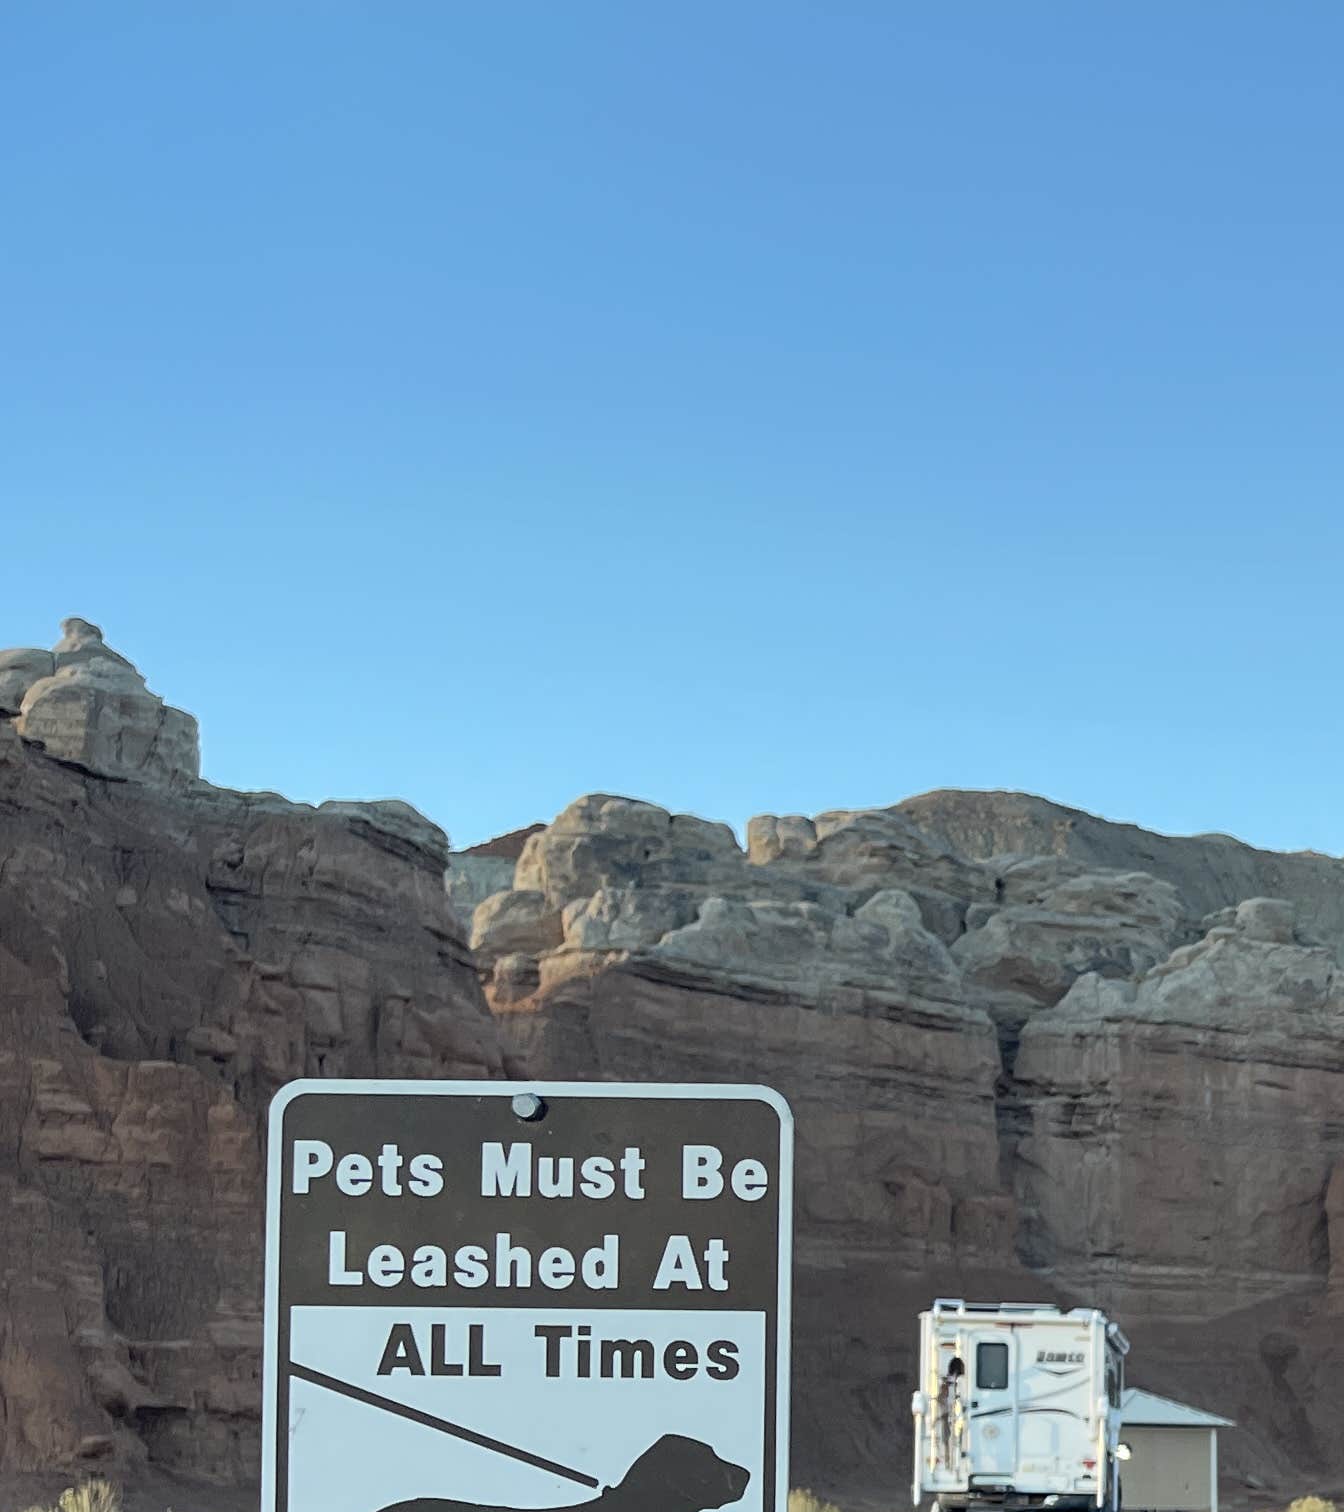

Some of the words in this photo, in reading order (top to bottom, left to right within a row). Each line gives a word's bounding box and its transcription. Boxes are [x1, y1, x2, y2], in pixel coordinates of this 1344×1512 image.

[292, 1139, 445, 1197] Pets
[480, 1141, 646, 1200] Must
[682, 1144, 769, 1202] Be
[328, 1230, 620, 1290] Leashed
[652, 1234, 730, 1292] At
[376, 1323, 503, 1377] ALL
[533, 1324, 741, 1381] Times
